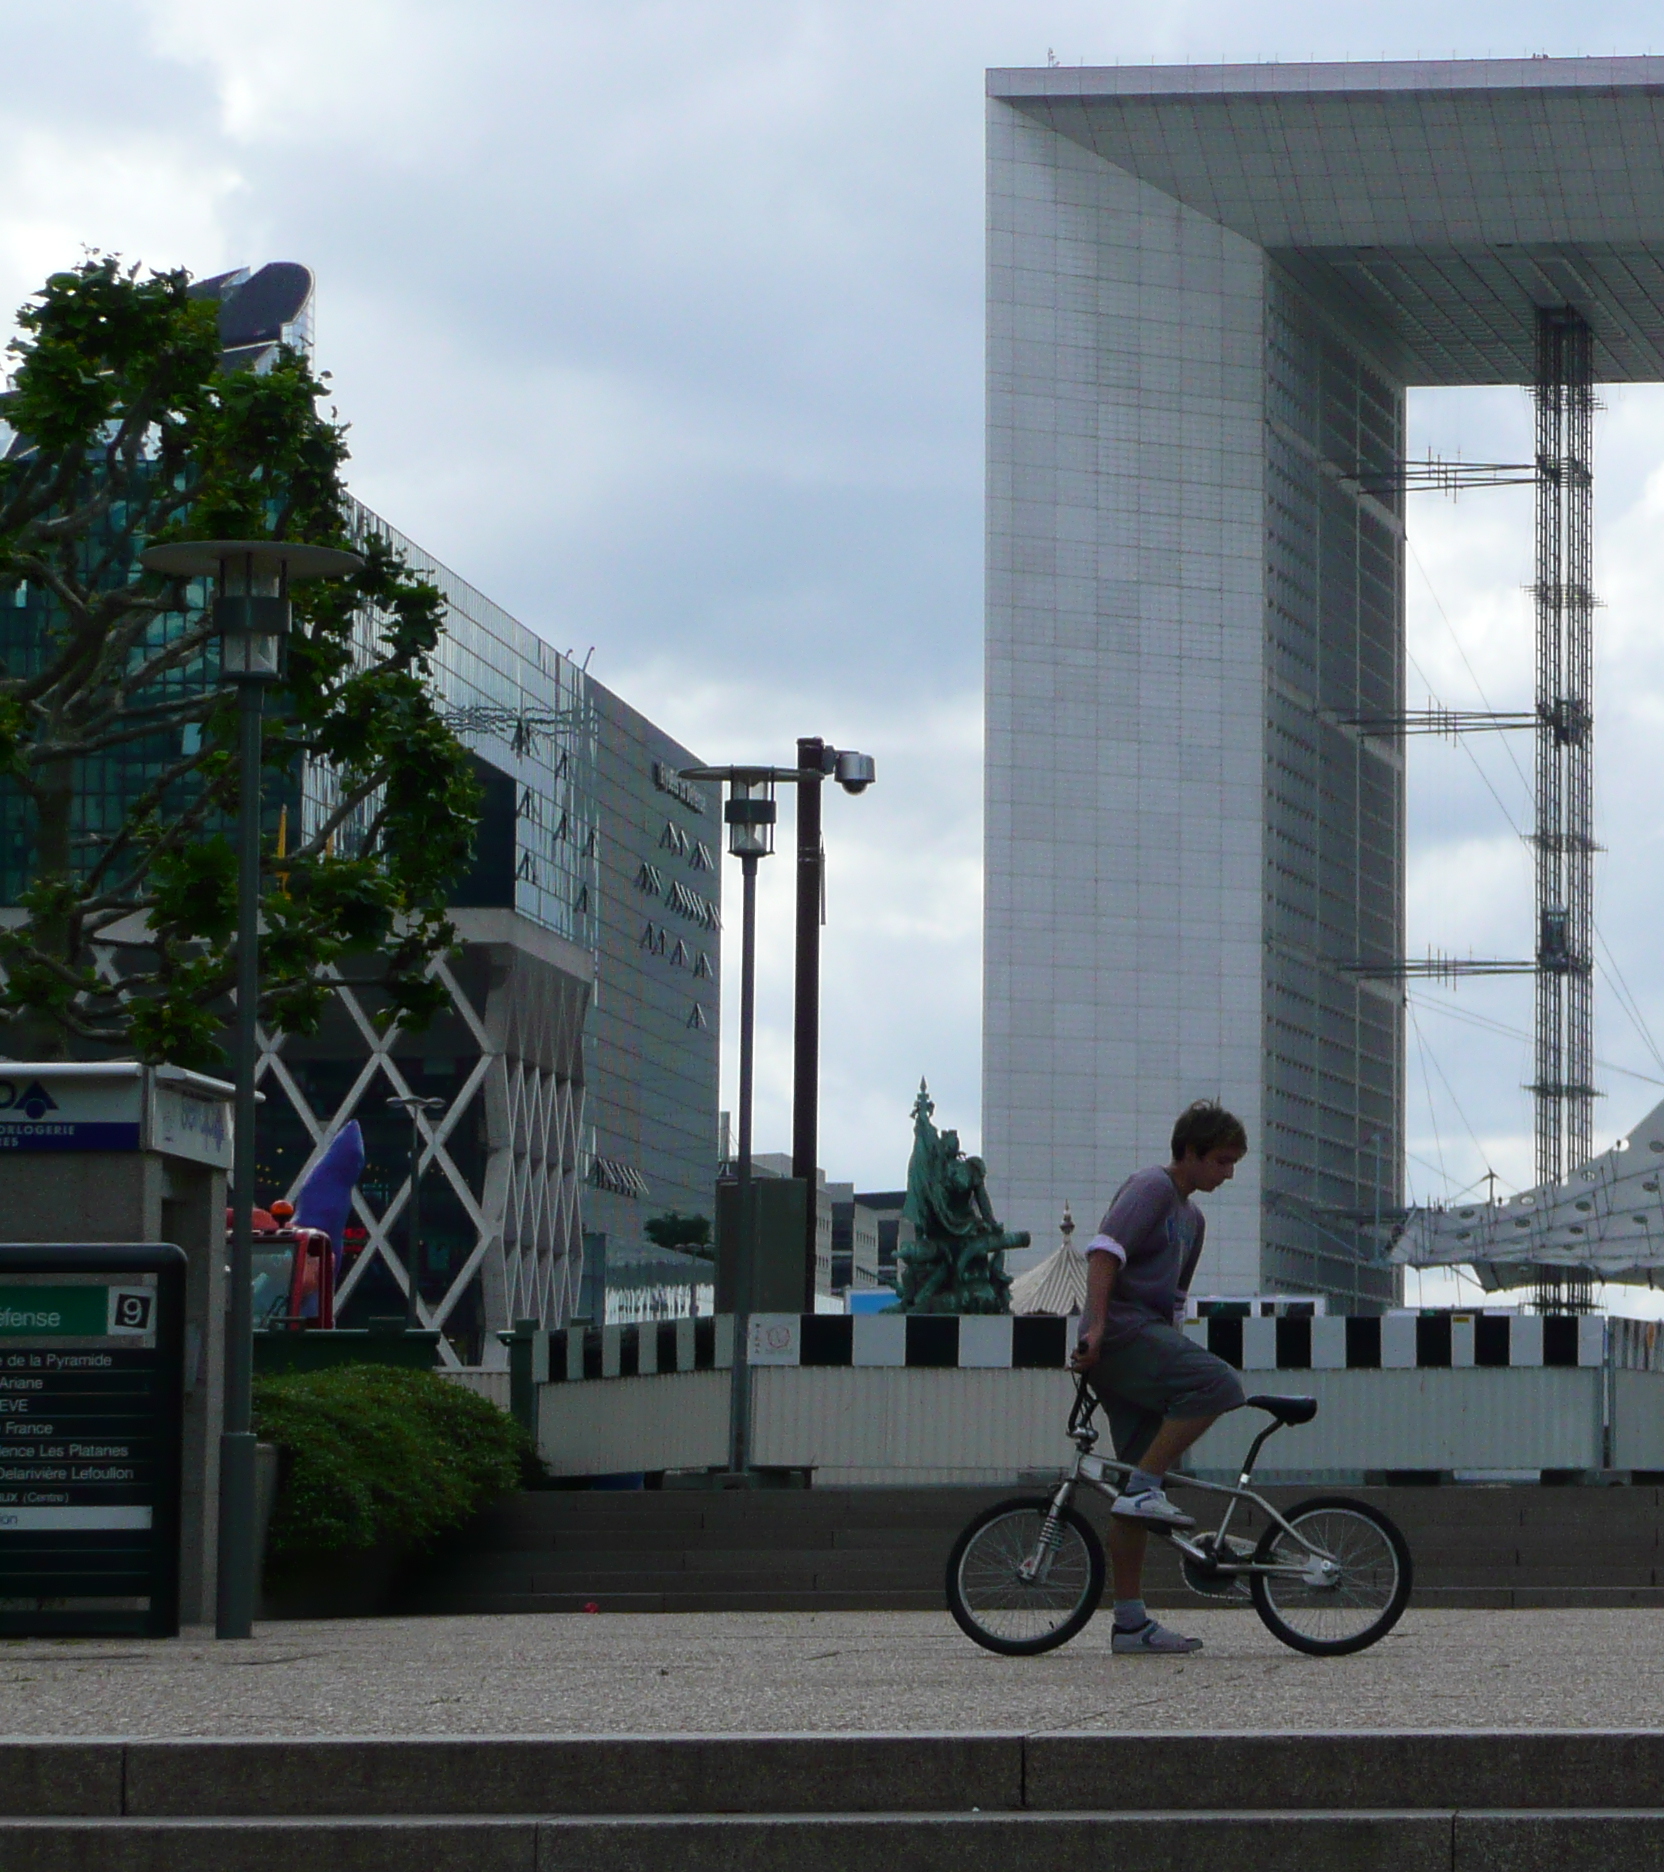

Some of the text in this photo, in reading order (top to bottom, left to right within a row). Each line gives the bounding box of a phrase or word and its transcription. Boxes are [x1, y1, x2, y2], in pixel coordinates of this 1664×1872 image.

[123, 1298, 143, 1325] 9
[7, 1354, 26, 1367] de
[30, 1354, 42, 1367] la
[46, 1353, 113, 1369] Pyramide
[5, 1421, 55, 1434] France
[39, 1444, 65, 1457] Les
[69, 1443, 130, 1457] Platanes
